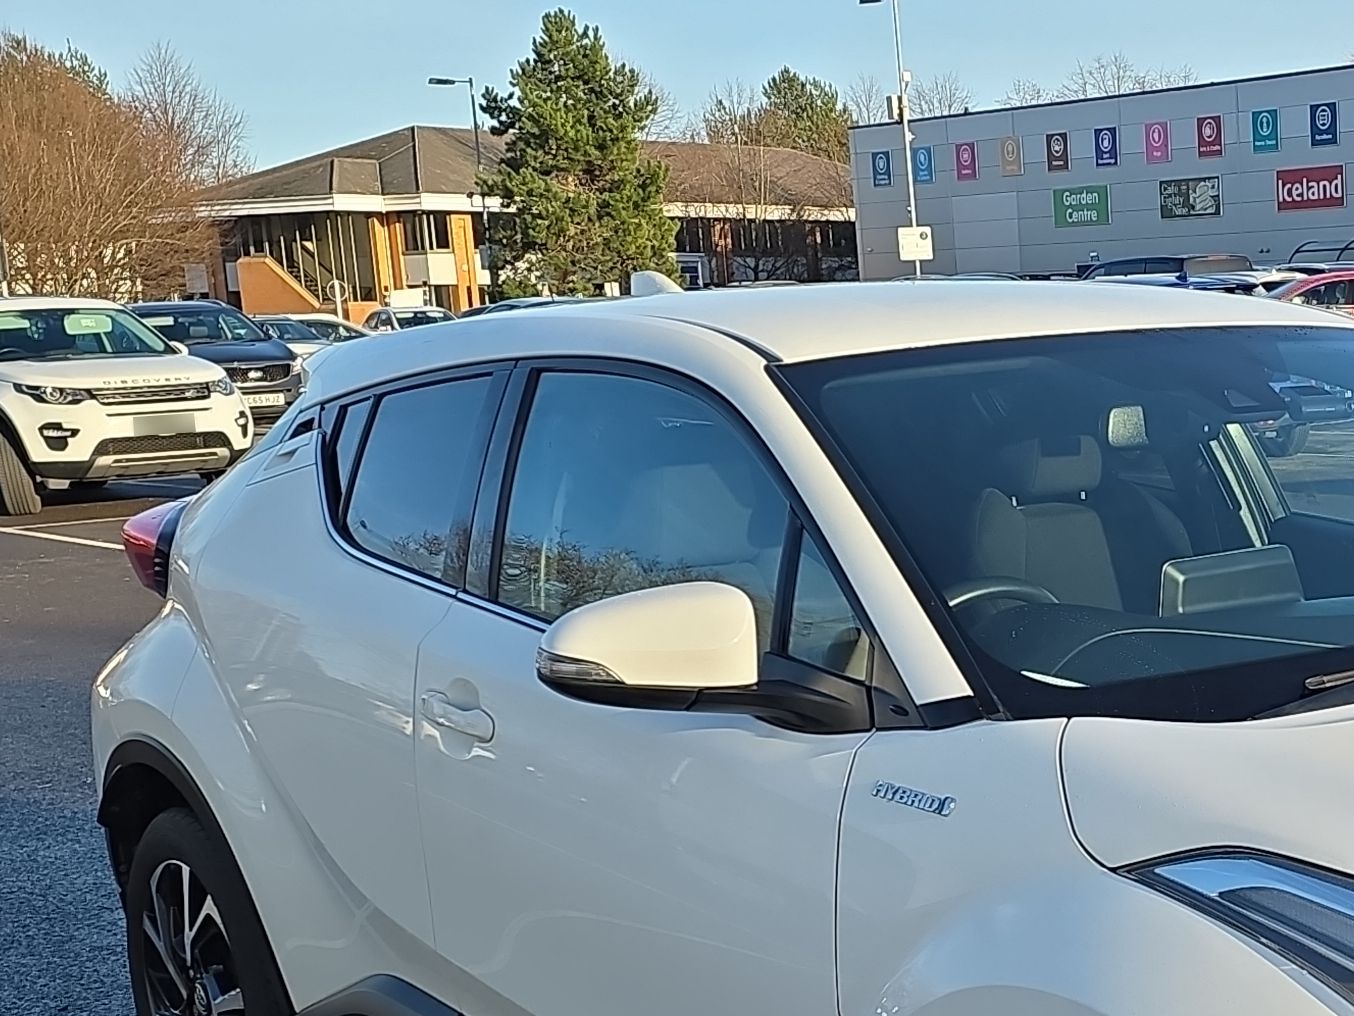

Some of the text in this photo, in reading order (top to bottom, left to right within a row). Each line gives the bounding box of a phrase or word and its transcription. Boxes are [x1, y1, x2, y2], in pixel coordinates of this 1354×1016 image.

[1278, 174, 1342, 203] Iceland
[1063, 190, 1099, 206] Garden
[1066, 208, 1098, 223] Centre
[102, 376, 191, 386] DISCOVERY
[244, 396, 264, 405] C65
[871, 779, 941, 813] HYBRID
